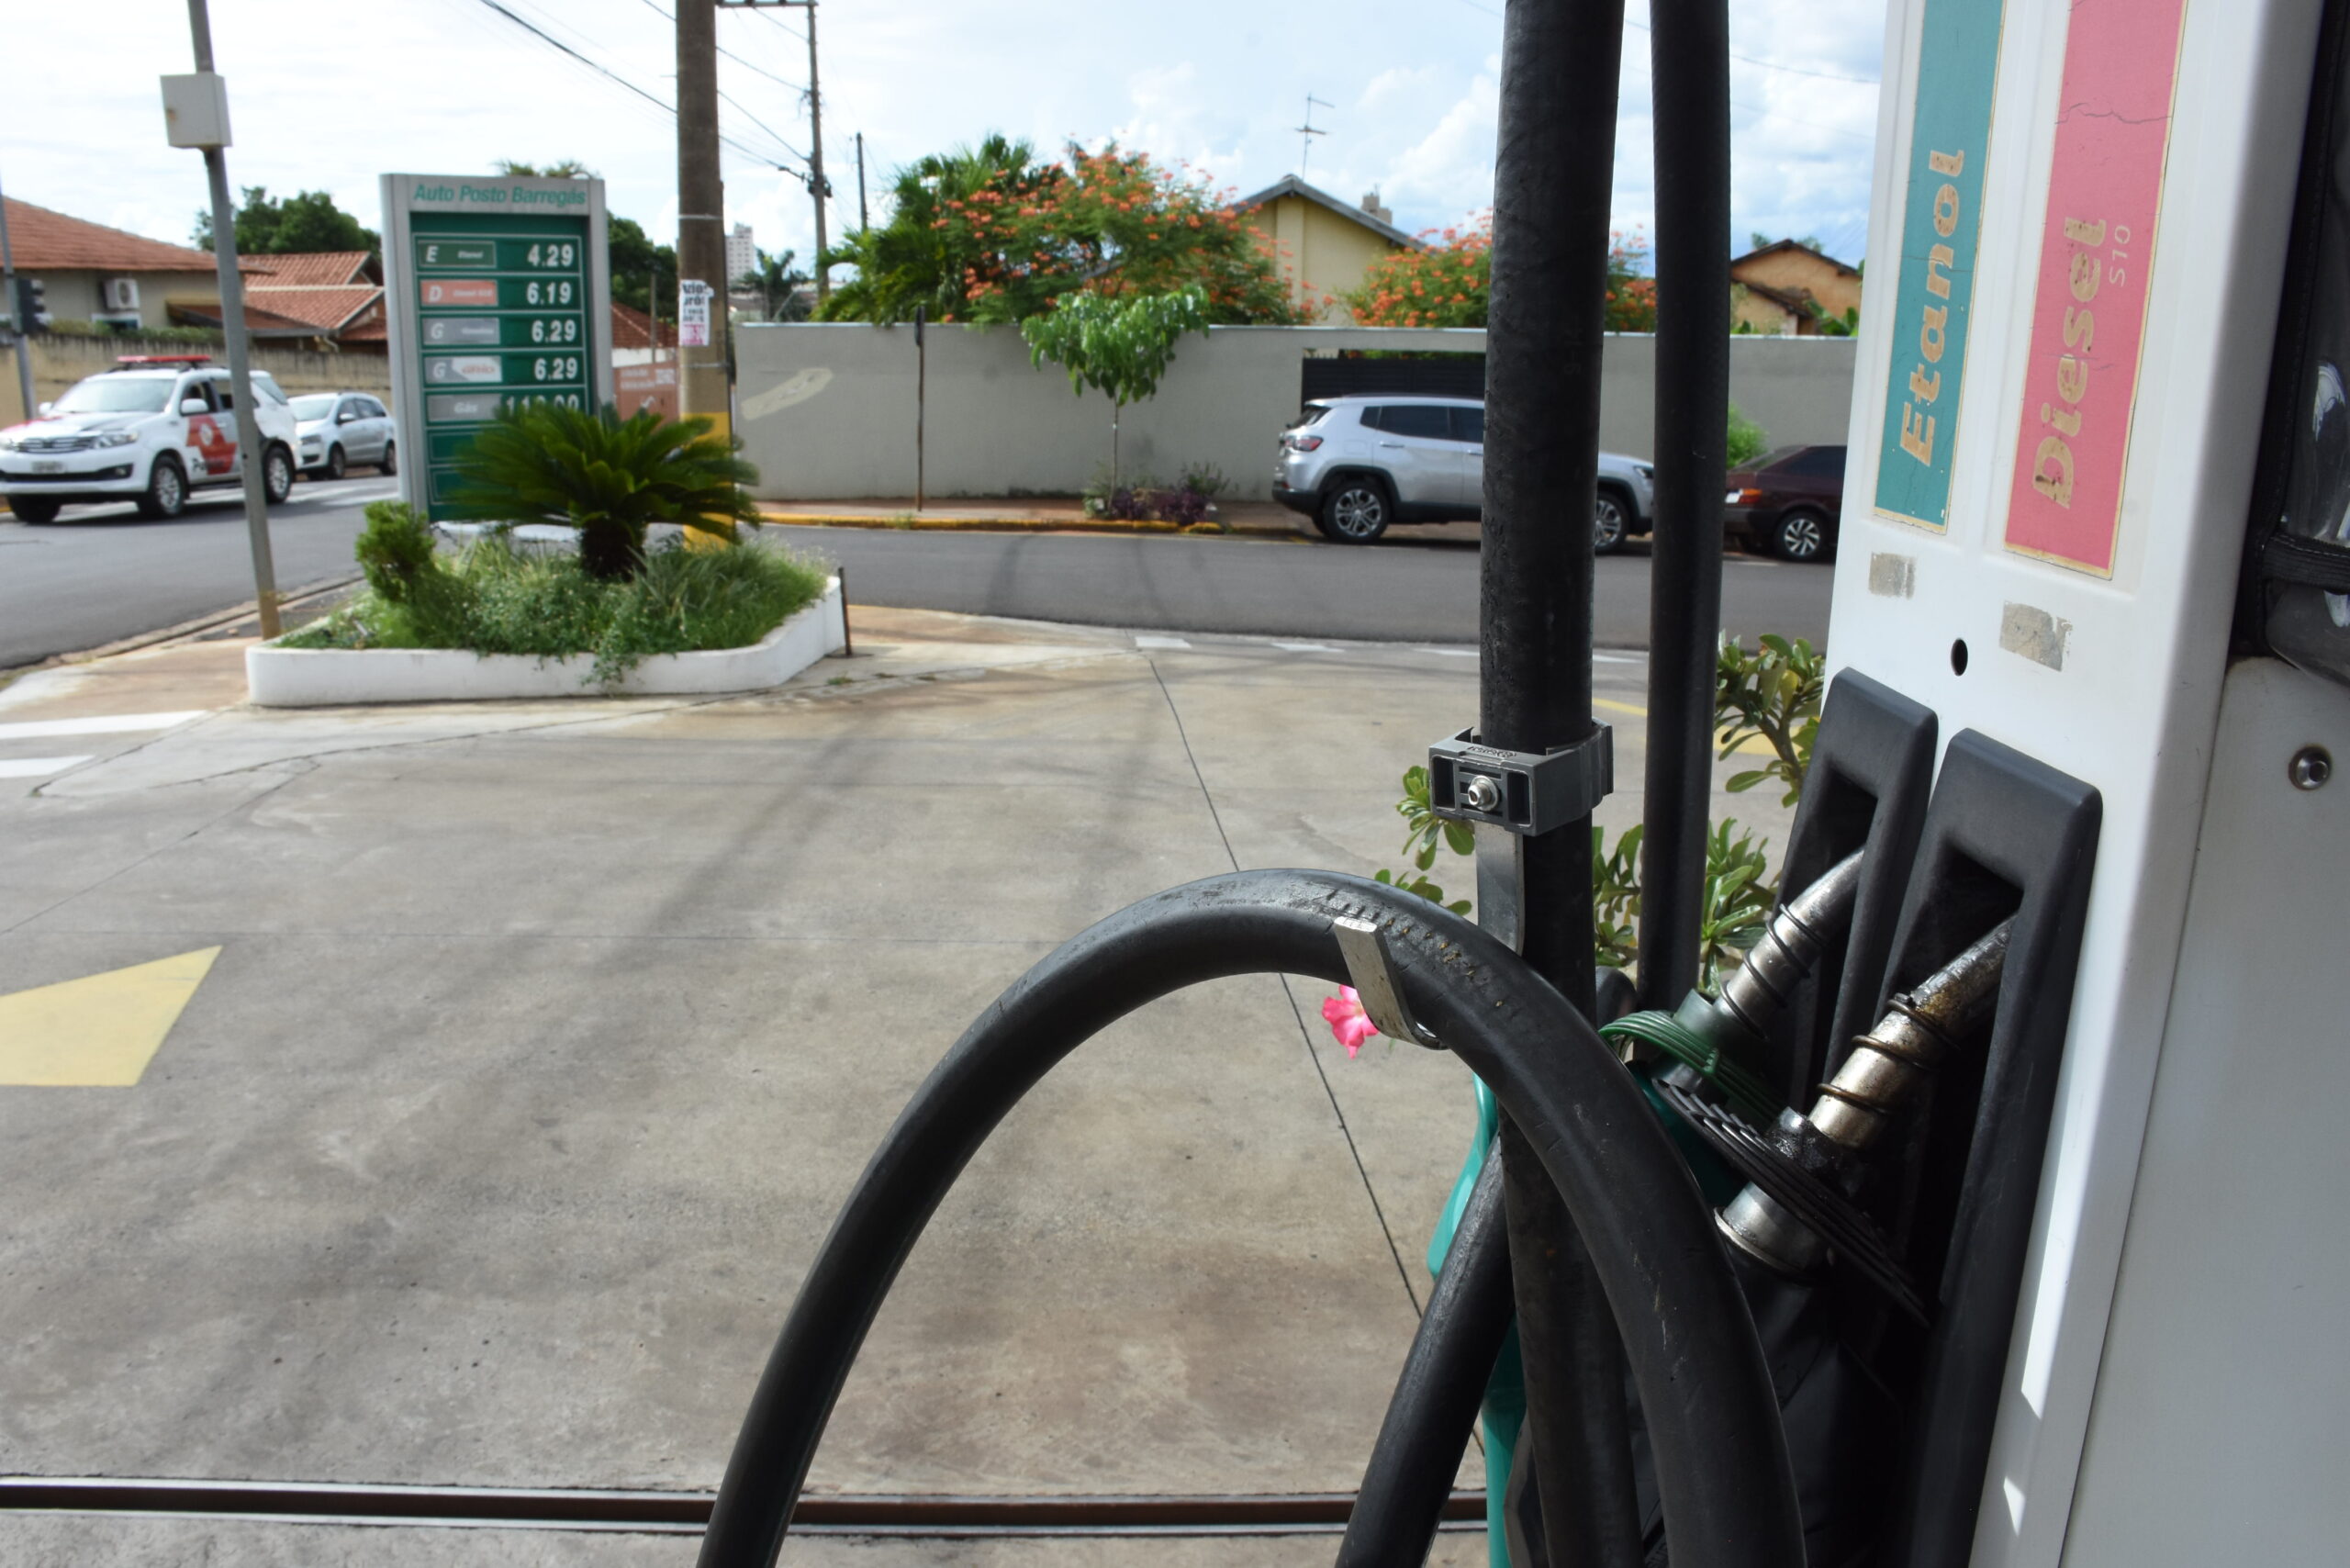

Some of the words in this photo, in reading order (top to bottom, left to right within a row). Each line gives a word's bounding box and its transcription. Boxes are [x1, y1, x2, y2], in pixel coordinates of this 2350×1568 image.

[414, 184, 455, 202] Auto
[459, 185, 507, 203] Posto
[426, 245, 439, 263] E
[527, 243, 574, 268] 4.29
[2109, 225, 2131, 287] S10
[428, 285, 442, 303] D
[526, 281, 573, 306] 6.19
[1900, 150, 1964, 467] Etanol
[431, 322, 444, 340] G
[532, 319, 576, 343] 6.29
[432, 361, 447, 379] G
[534, 357, 578, 381] 6.29
[2032, 217, 2107, 510] Diesel
